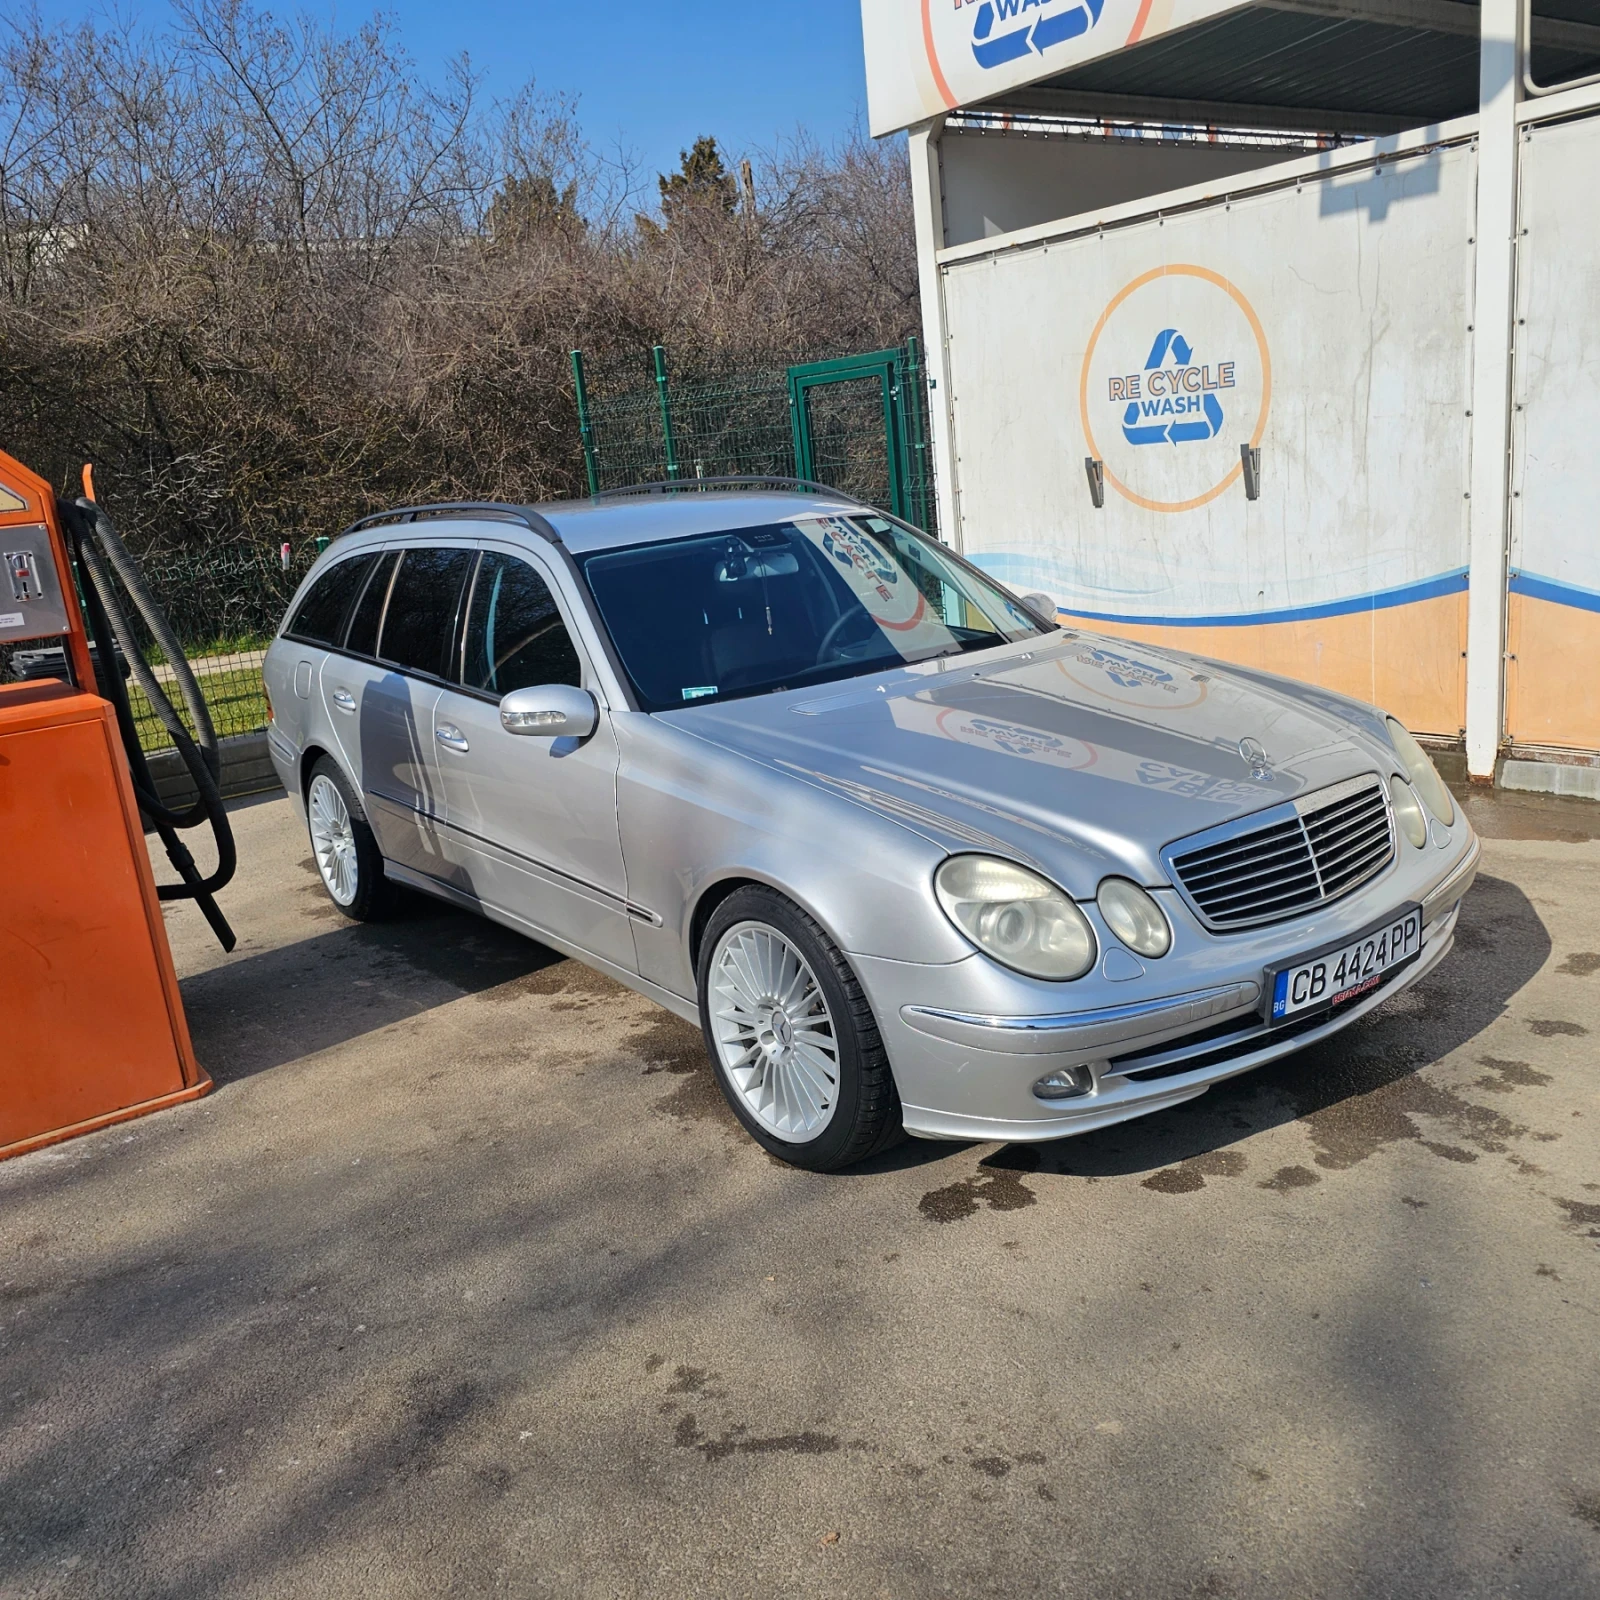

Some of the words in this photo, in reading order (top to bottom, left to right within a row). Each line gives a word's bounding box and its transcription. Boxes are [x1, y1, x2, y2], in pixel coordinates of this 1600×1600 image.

[1108, 374, 1141, 401] RE
[1147, 361, 1235, 397] CYCLE
[1141, 395, 1200, 417] WASH
[1291, 962, 1326, 1004] CB
[1332, 932, 1387, 987] 4424
[1390, 916, 1416, 961] PP
[1273, 1000, 1285, 1013] BG
